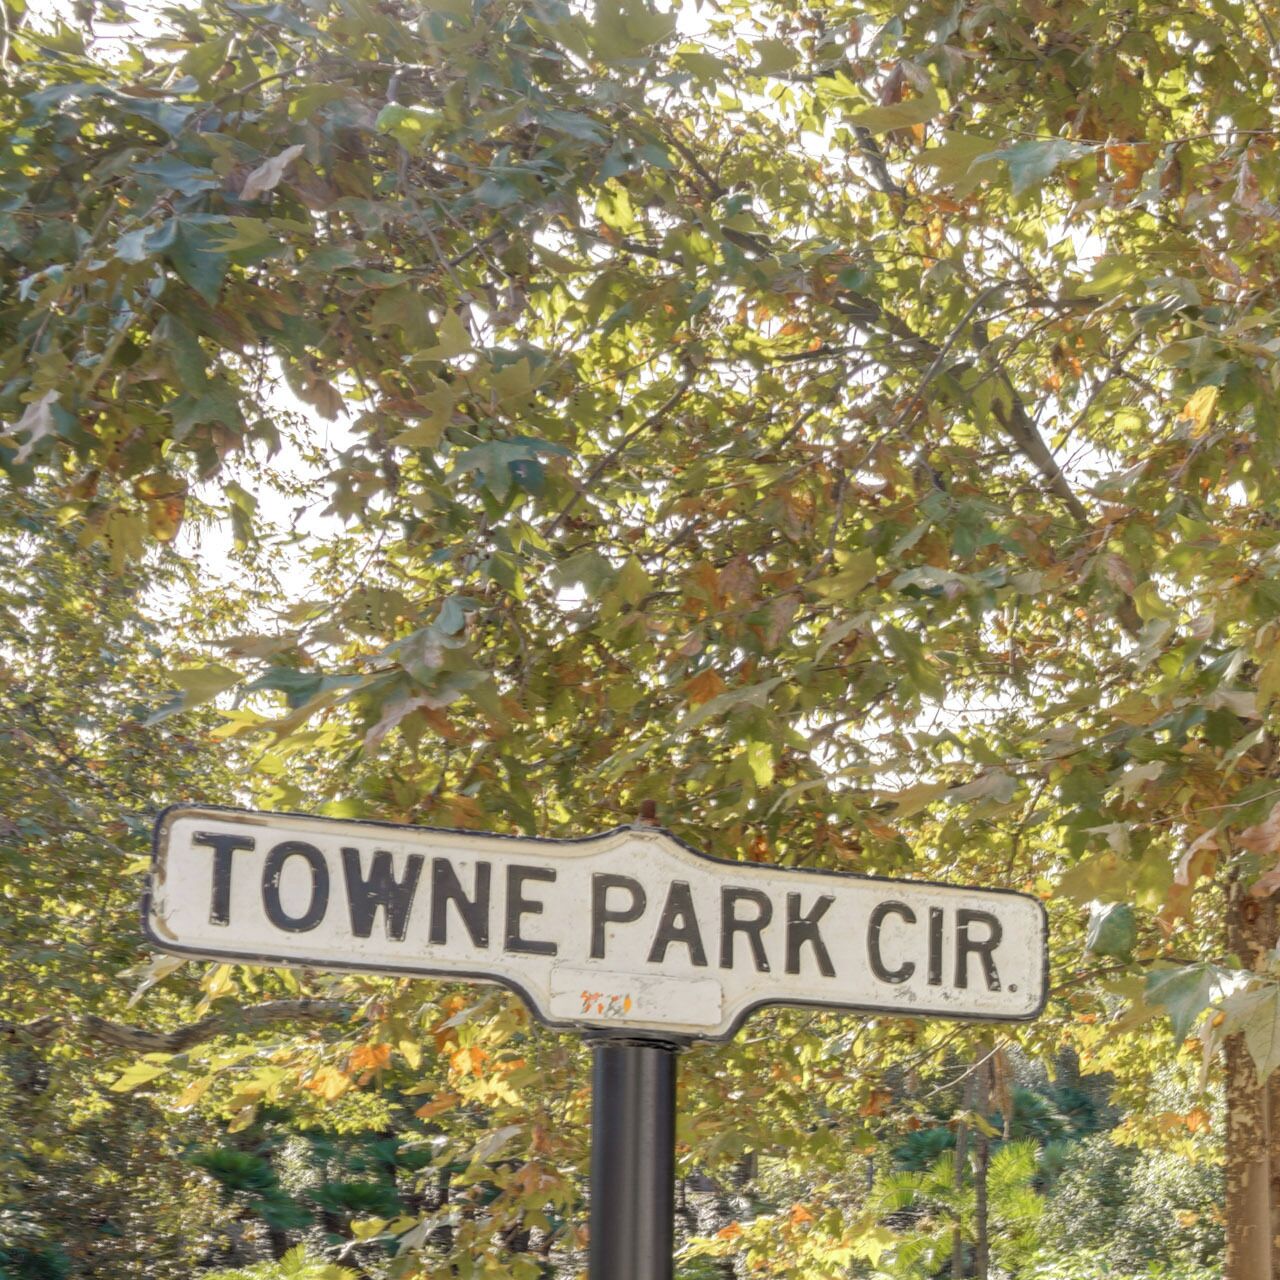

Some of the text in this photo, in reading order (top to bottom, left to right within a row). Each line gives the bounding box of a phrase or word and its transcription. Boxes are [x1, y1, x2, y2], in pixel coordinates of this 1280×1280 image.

[192, 832, 1018, 994] TOWNE PARK CIR.
